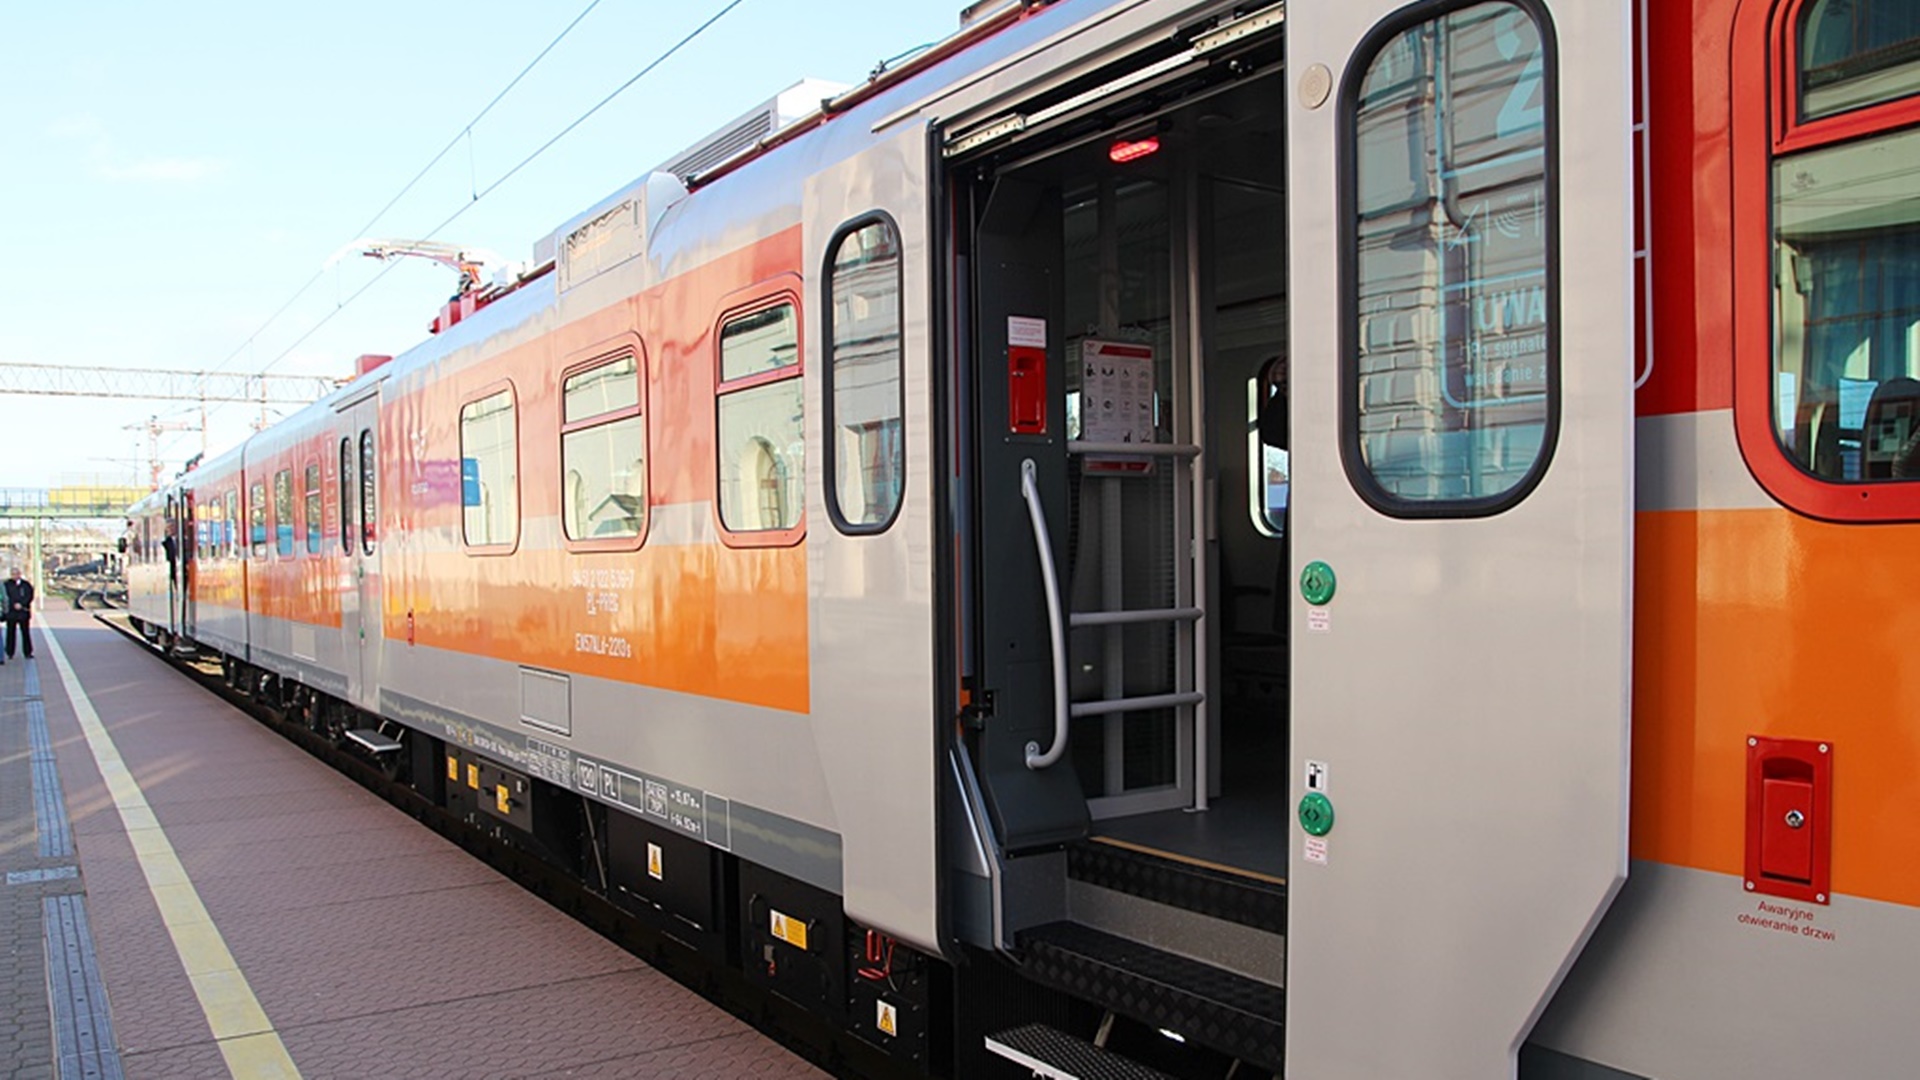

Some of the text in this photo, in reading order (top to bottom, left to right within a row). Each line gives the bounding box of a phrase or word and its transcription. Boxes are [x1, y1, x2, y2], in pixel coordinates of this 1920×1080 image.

[604, 772, 617, 797] PL
[1757, 900, 1814, 921] Awaryjne
[1737, 913, 1836, 941] otwieranie drzwi
